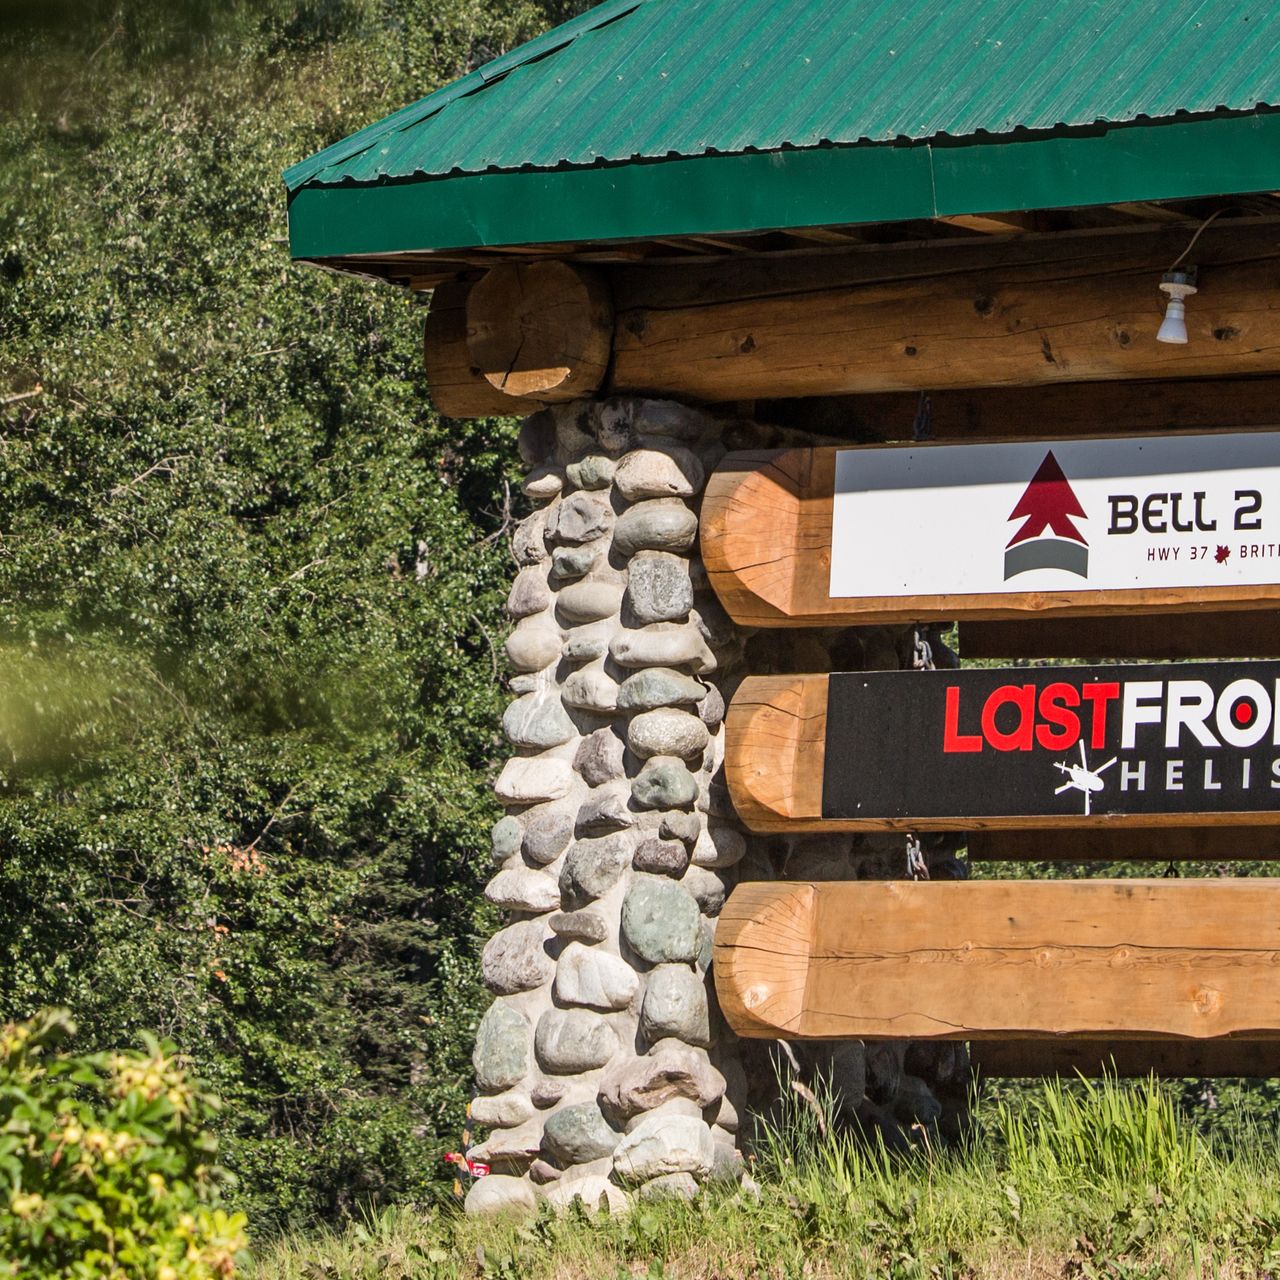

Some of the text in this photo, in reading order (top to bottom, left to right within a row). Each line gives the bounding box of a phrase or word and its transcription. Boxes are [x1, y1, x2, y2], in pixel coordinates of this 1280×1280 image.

[1107, 491, 1218, 536] BELL
[1233, 489, 1263, 531] 2
[1147, 546, 1181, 562] HWY
[1190, 545, 1209, 561] 37
